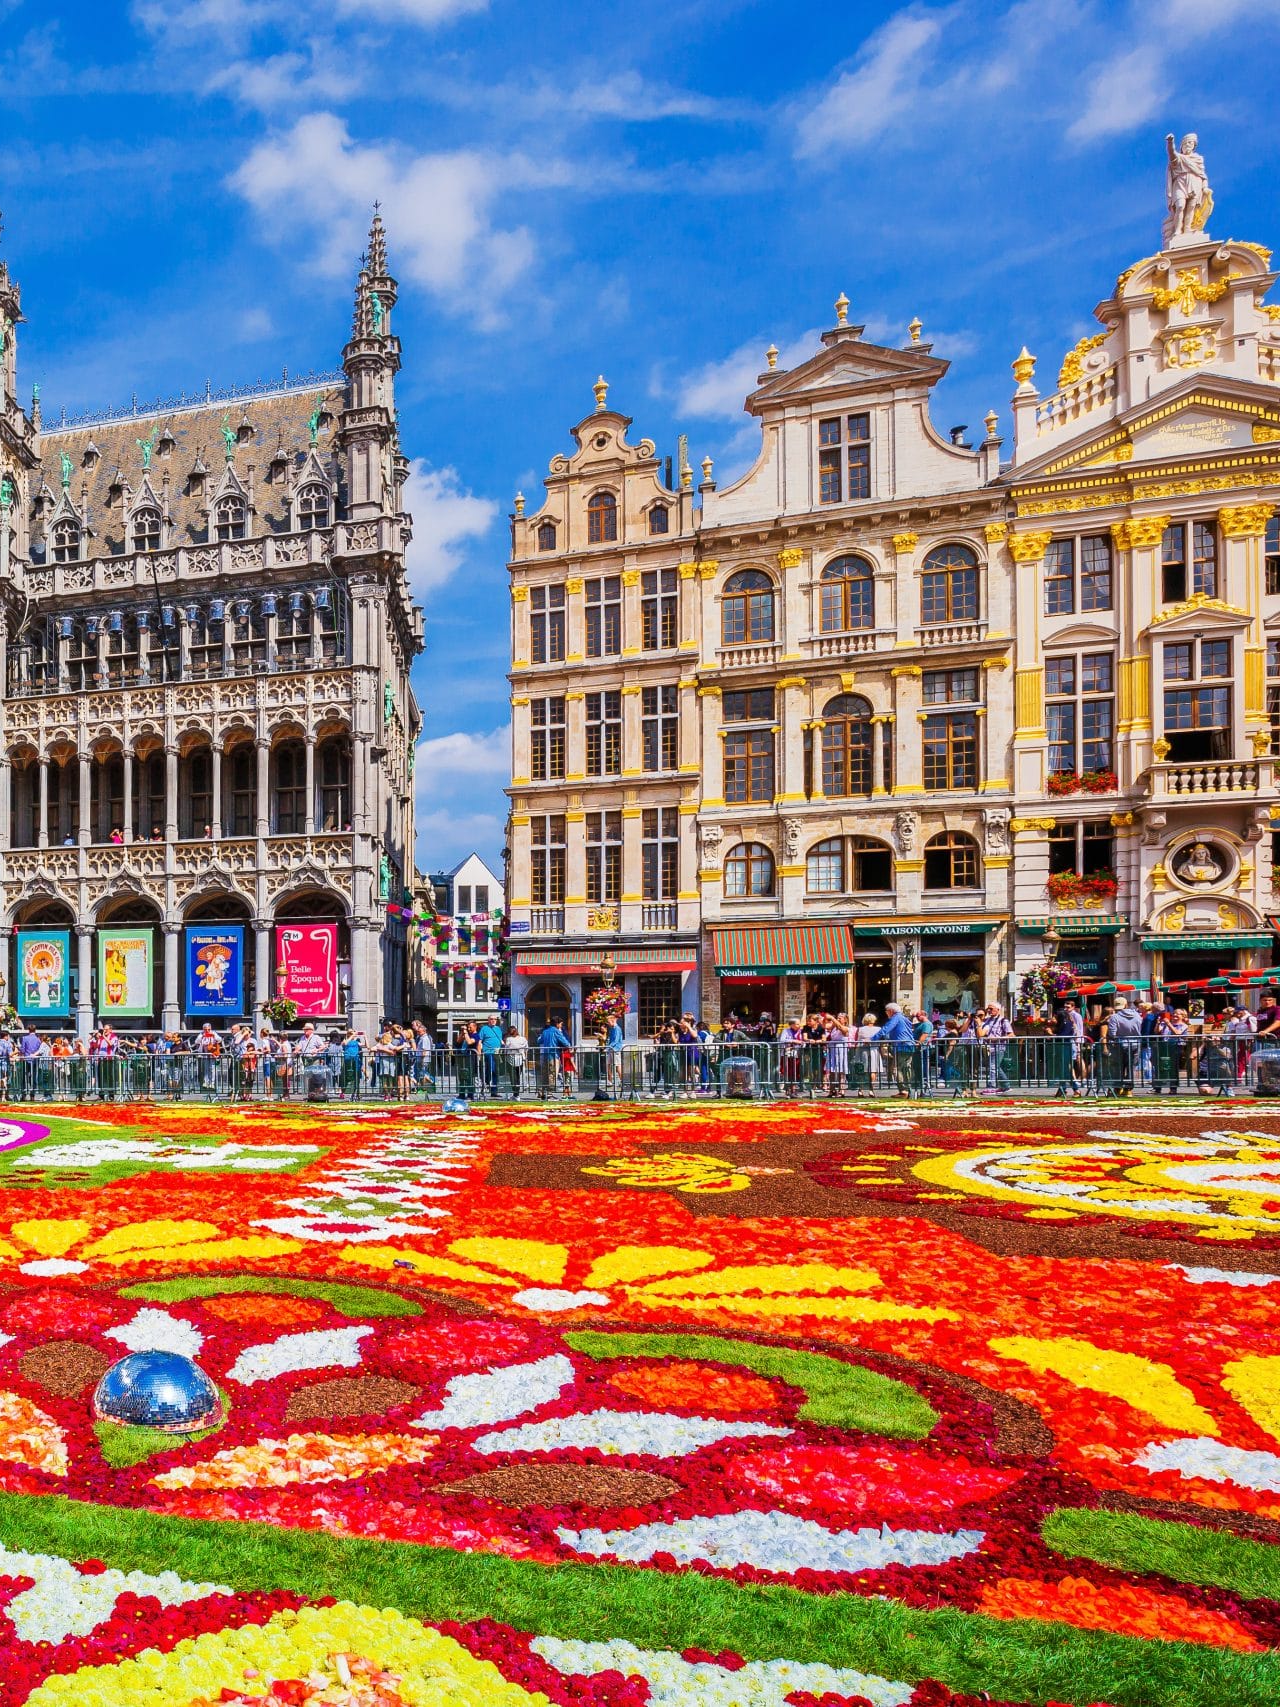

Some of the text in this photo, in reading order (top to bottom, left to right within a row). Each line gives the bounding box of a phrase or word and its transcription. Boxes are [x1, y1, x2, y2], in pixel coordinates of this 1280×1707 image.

[881, 925, 971, 935] MAISON ANTOINE
[291, 965, 312, 973] Belle
[720, 968, 758, 977] Neuhaus
[291, 974, 323, 985] Epoque
